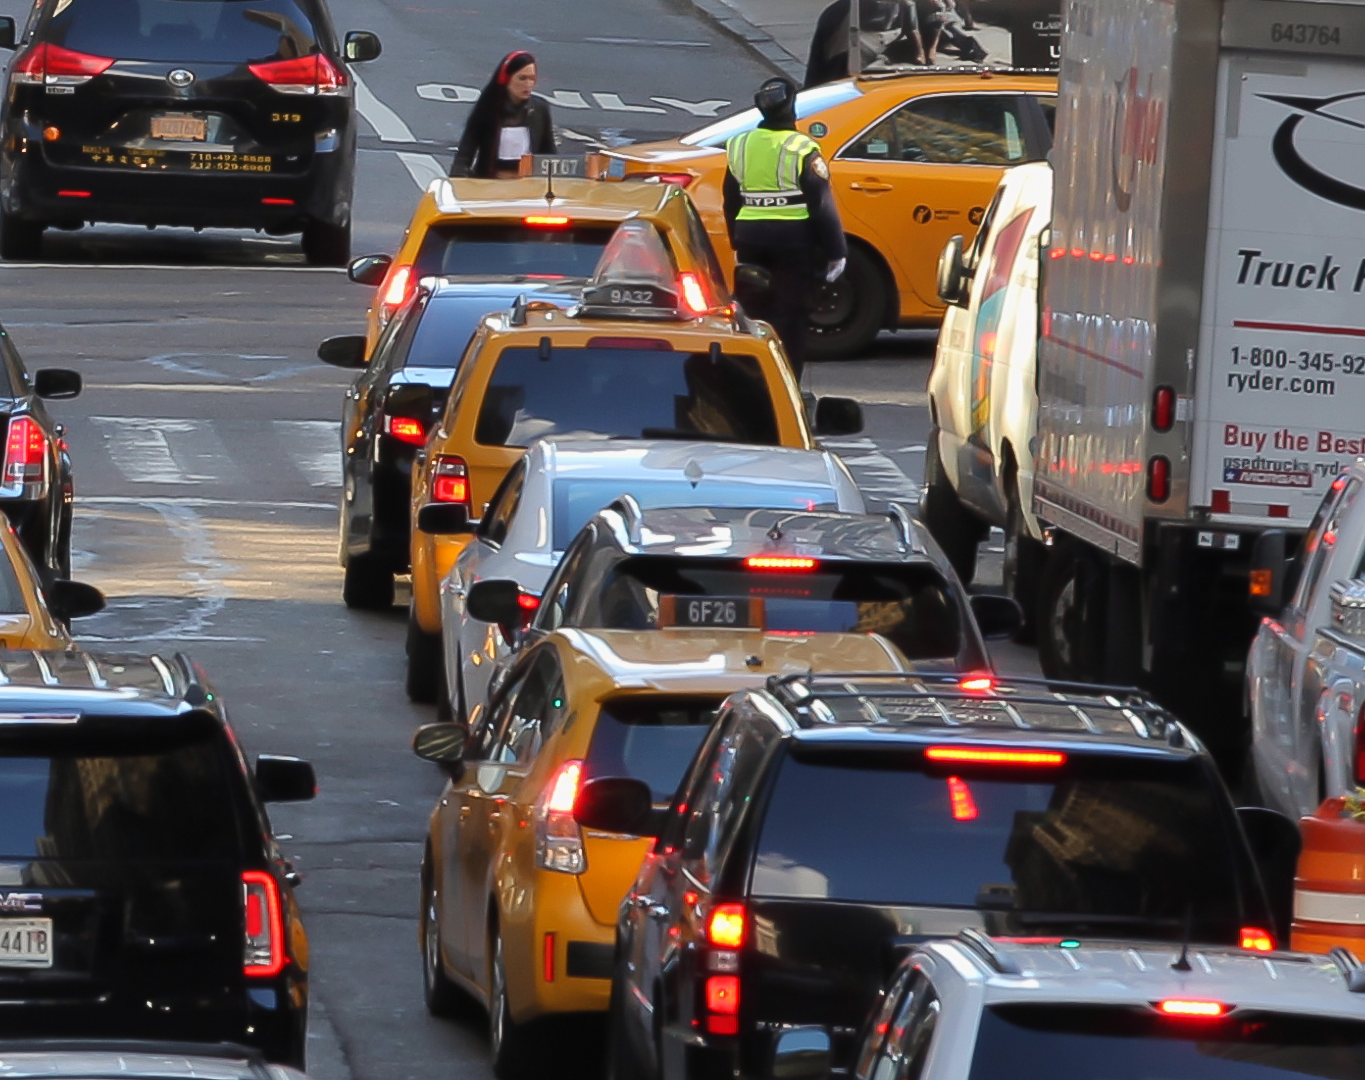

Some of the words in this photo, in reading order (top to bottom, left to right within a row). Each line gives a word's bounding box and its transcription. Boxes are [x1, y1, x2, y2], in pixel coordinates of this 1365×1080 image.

[1269, 22, 1342, 47] 643764
[272, 113, 302, 123] 319
[745, 196, 788, 207] NYPD
[1235, 249, 1343, 293] Truck
[610, 288, 654, 305] 9A32
[1227, 370, 1336, 397] ryder.com
[1222, 424, 1267, 455] Buy
[1273, 428, 1309, 453] the
[688, 600, 738, 624] 6F26
